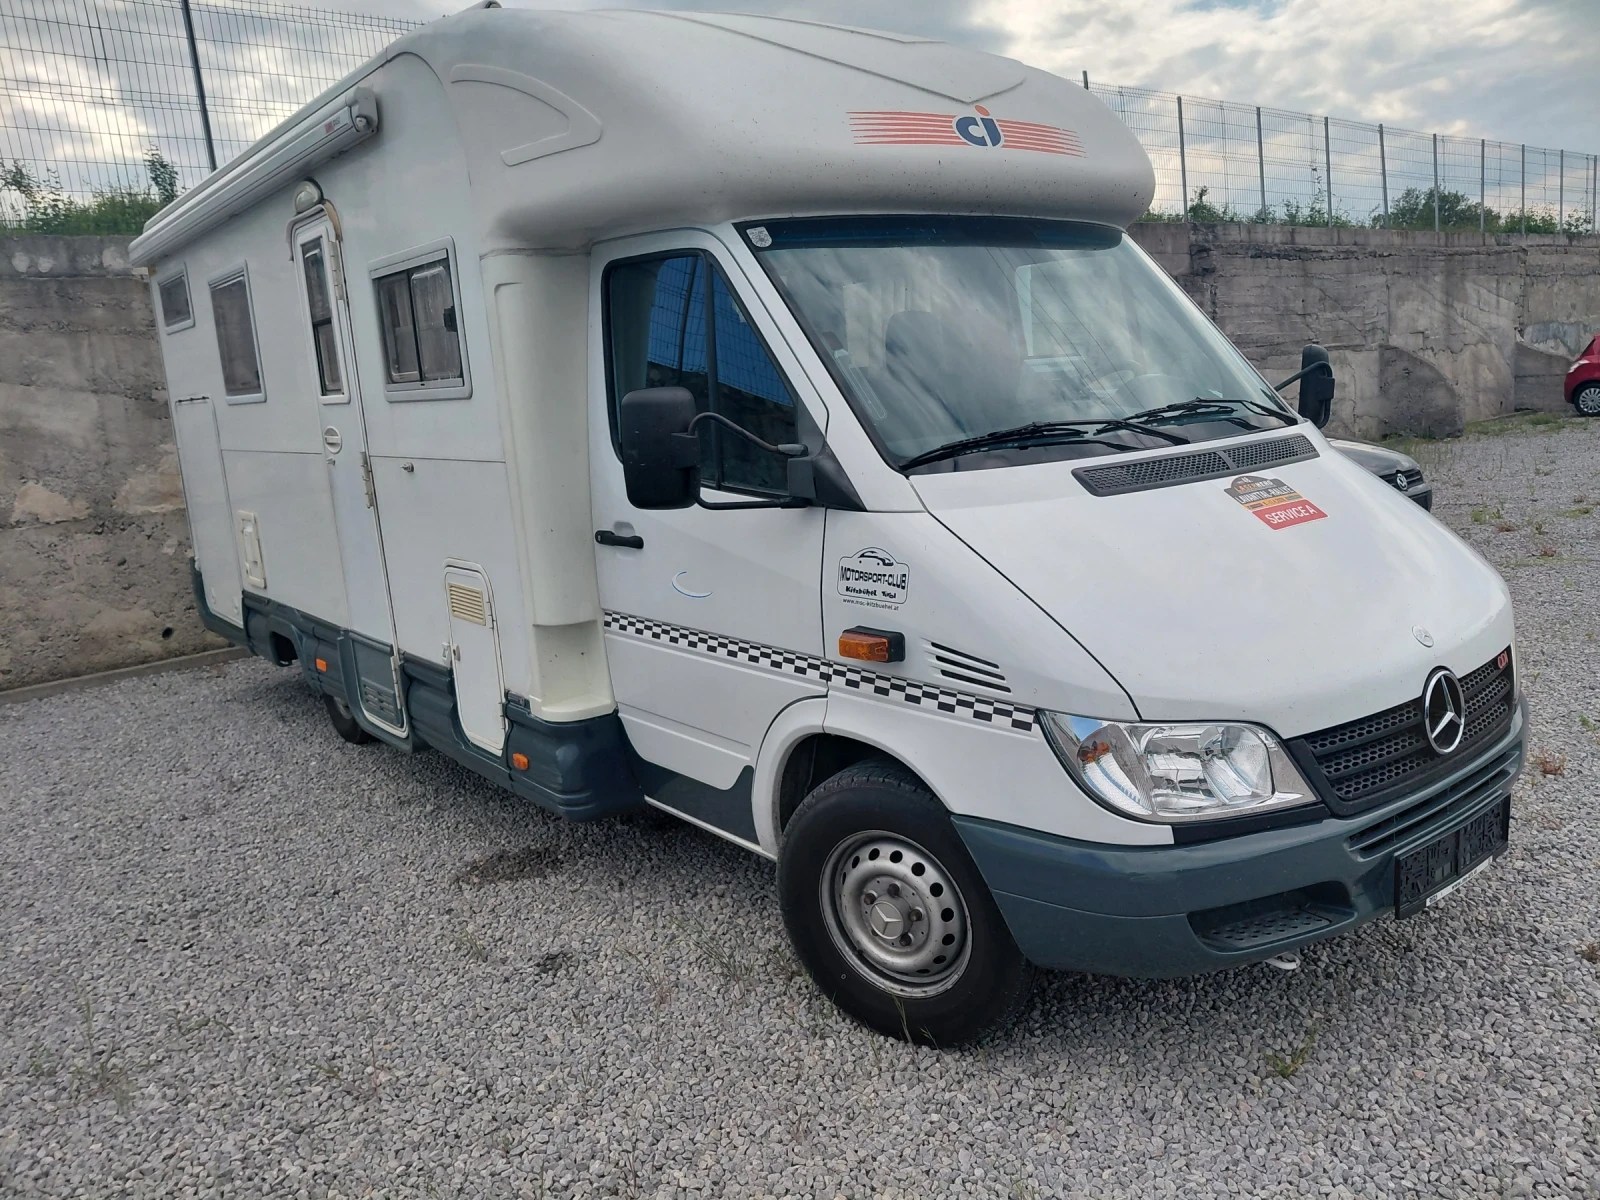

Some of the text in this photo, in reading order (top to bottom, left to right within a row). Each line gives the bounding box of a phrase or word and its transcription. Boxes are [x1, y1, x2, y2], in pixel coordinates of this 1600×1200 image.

[1265, 505, 1317, 524] SERVICE A
[840, 566, 906, 590] MOTORSPORT-CLUB
[842, 598, 899, 611] www.msc-kitzbuehel.at
